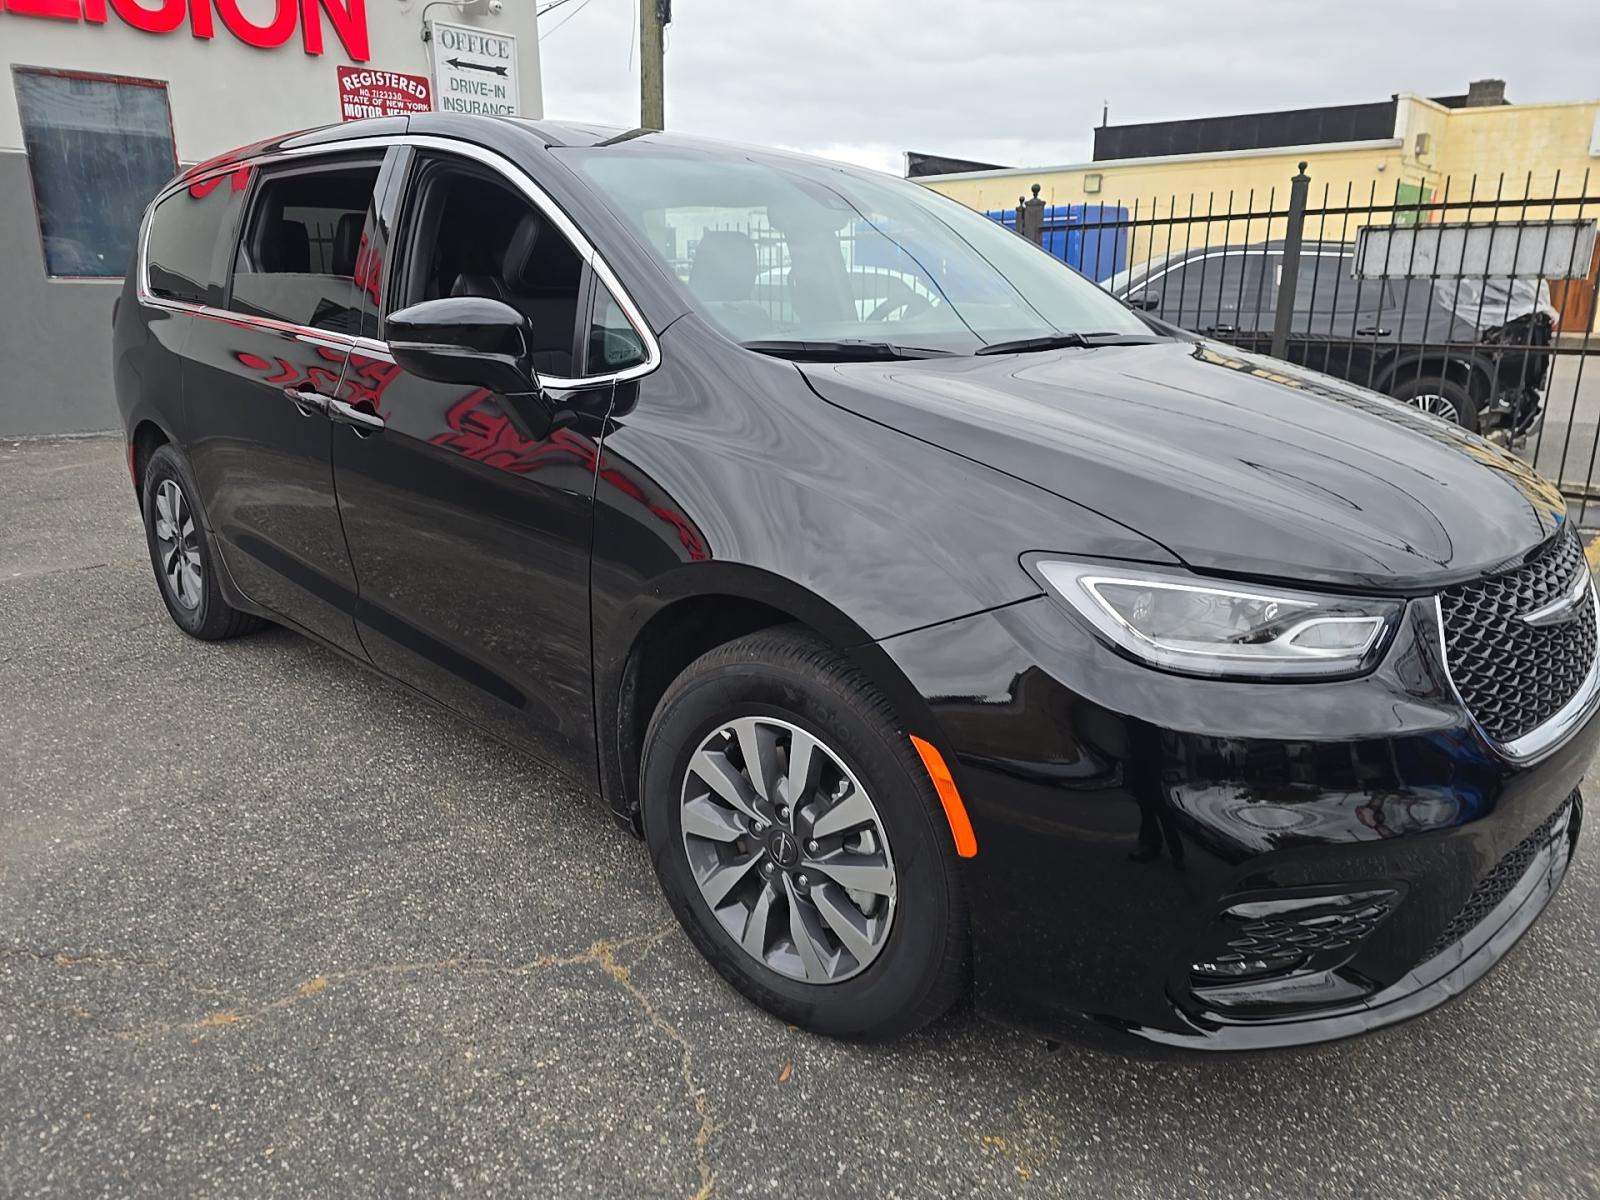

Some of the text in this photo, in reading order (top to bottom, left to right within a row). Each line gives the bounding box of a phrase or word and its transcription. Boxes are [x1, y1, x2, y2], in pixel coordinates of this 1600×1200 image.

[441, 29, 509, 59] OFFICE
[342, 72, 426, 98] REGISTERED
[450, 77, 506, 99] DRIVE-IN
[344, 95, 369, 104] STATE
[387, 99, 403, 108] NEW
[407, 103, 428, 111] YORK
[344, 103, 382, 118] MOTOR
